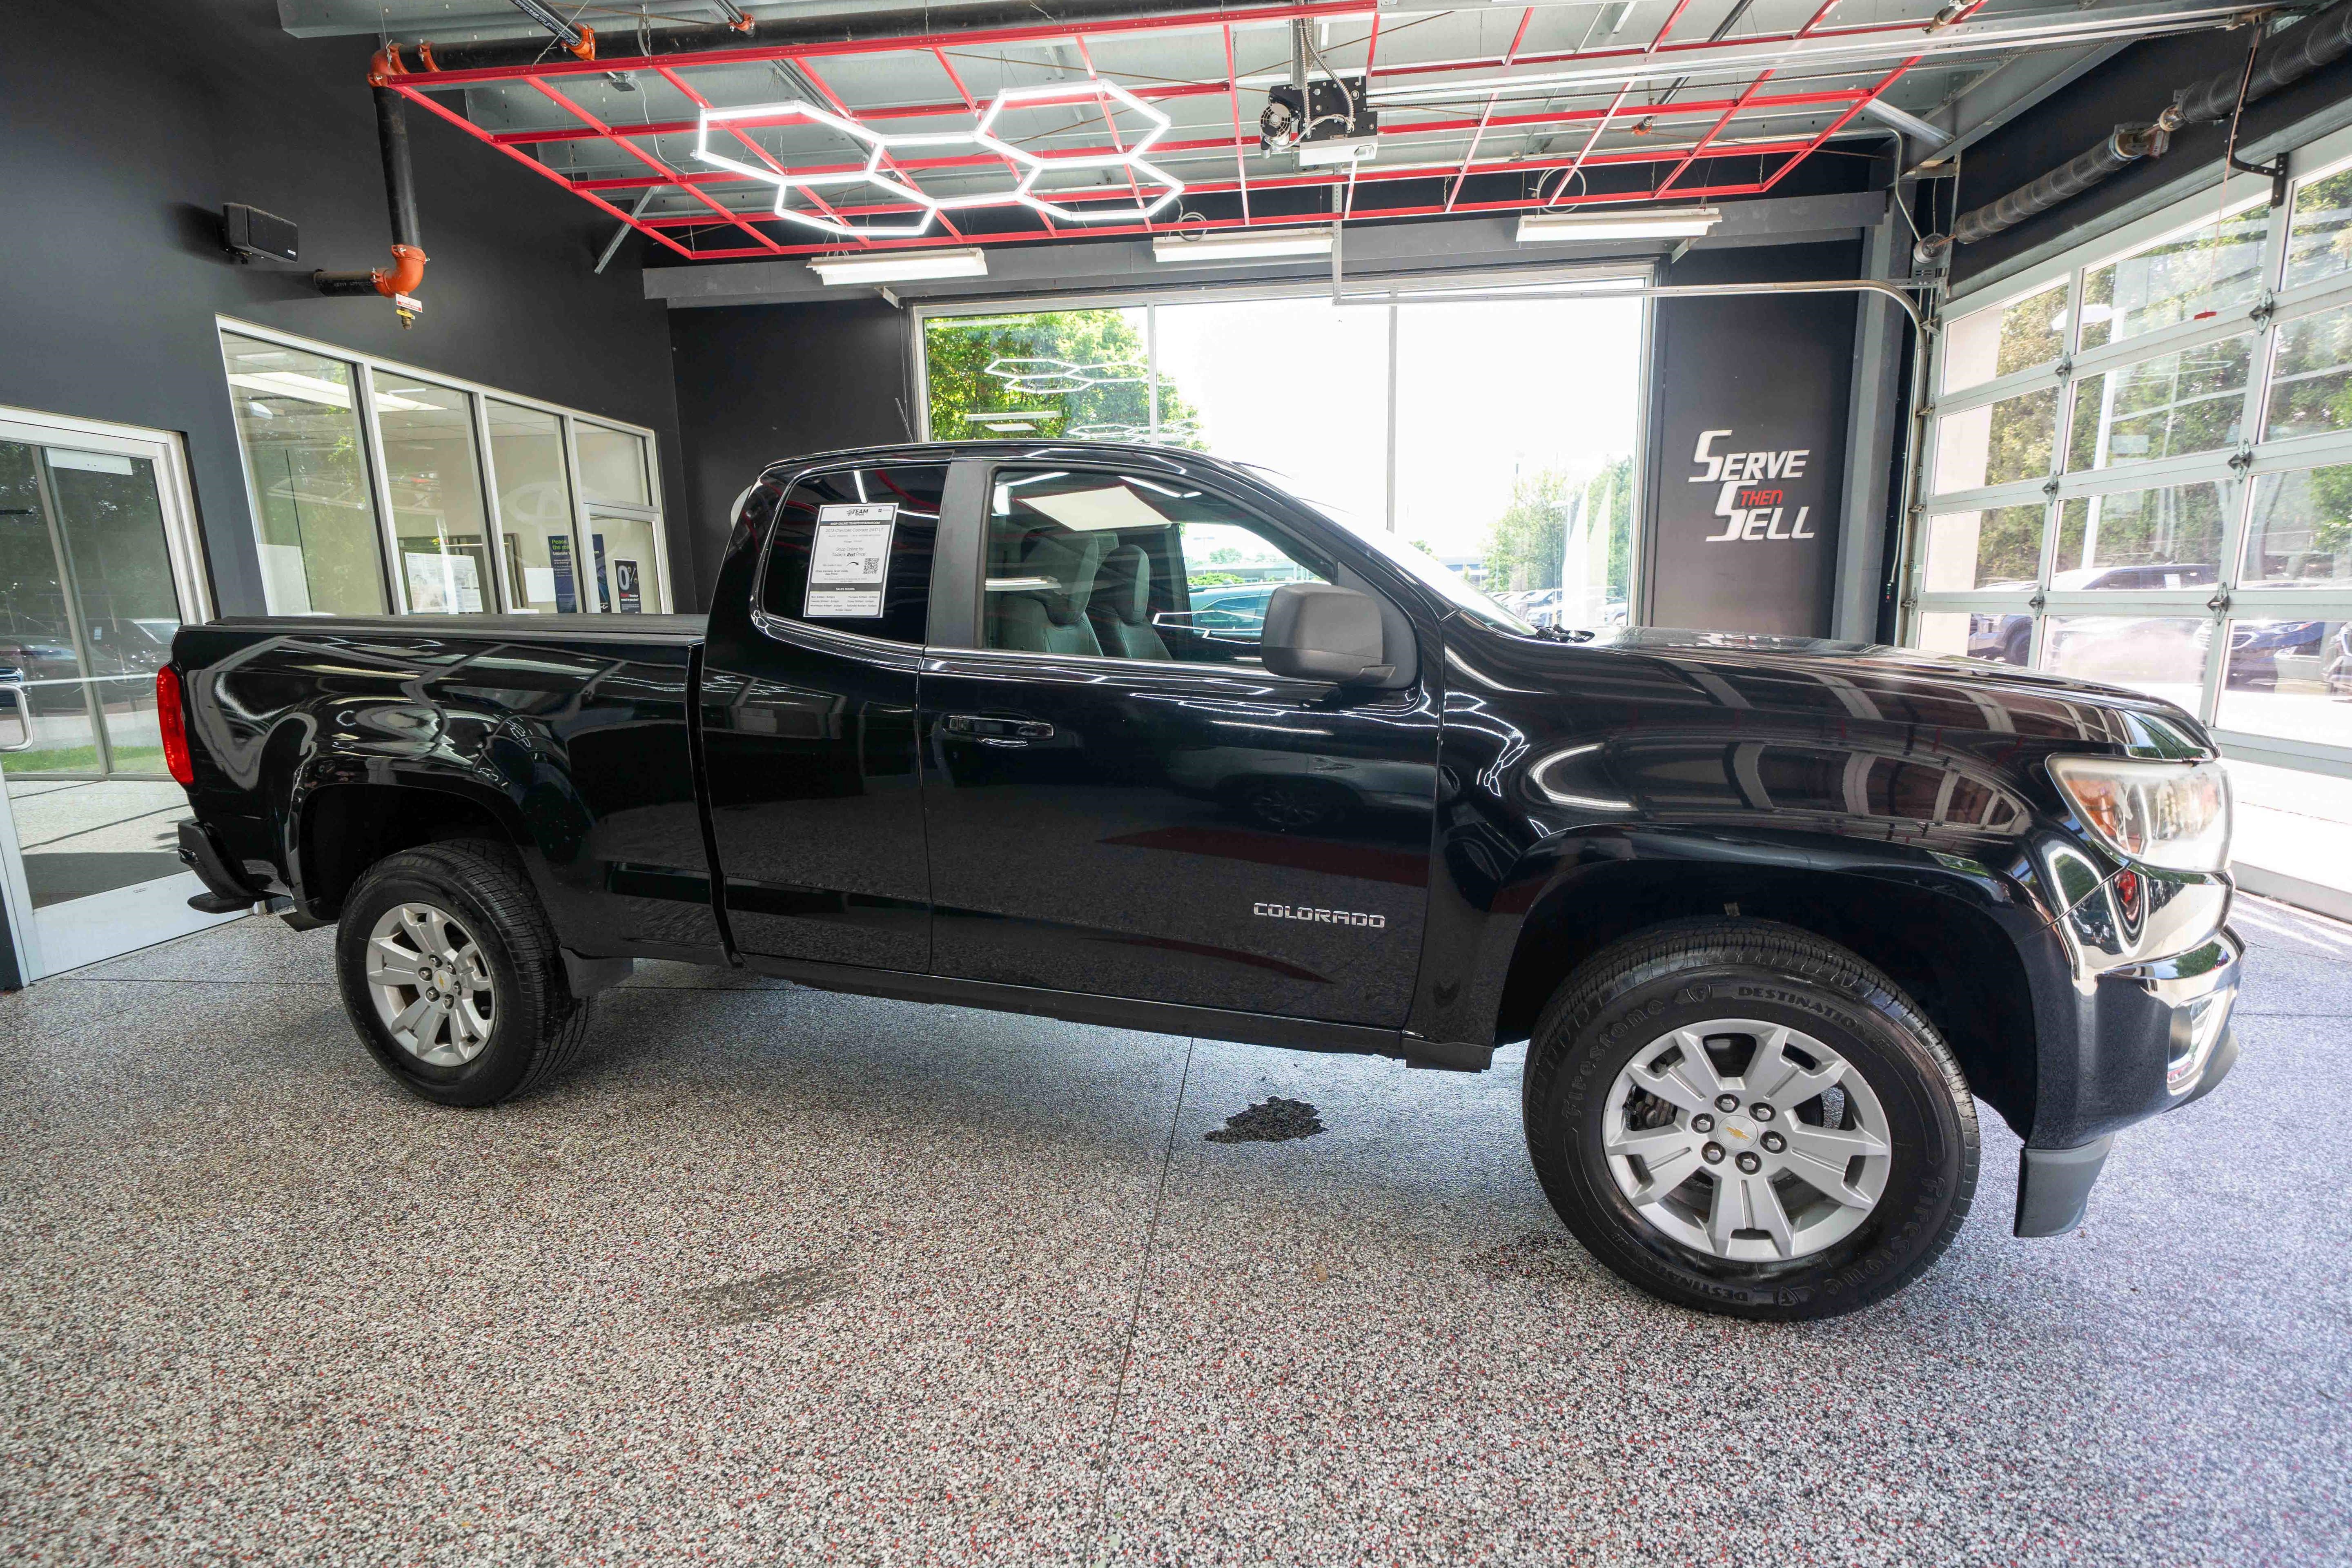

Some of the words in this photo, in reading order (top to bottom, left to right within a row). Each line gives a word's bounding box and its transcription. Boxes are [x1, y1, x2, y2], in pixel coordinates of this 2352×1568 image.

[1688, 430, 1810, 482] SERVE
[1705, 479, 1815, 542] SELL
[1254, 903, 1385, 928] COLORADO
[1738, 986, 1867, 1038] DESTINATION
